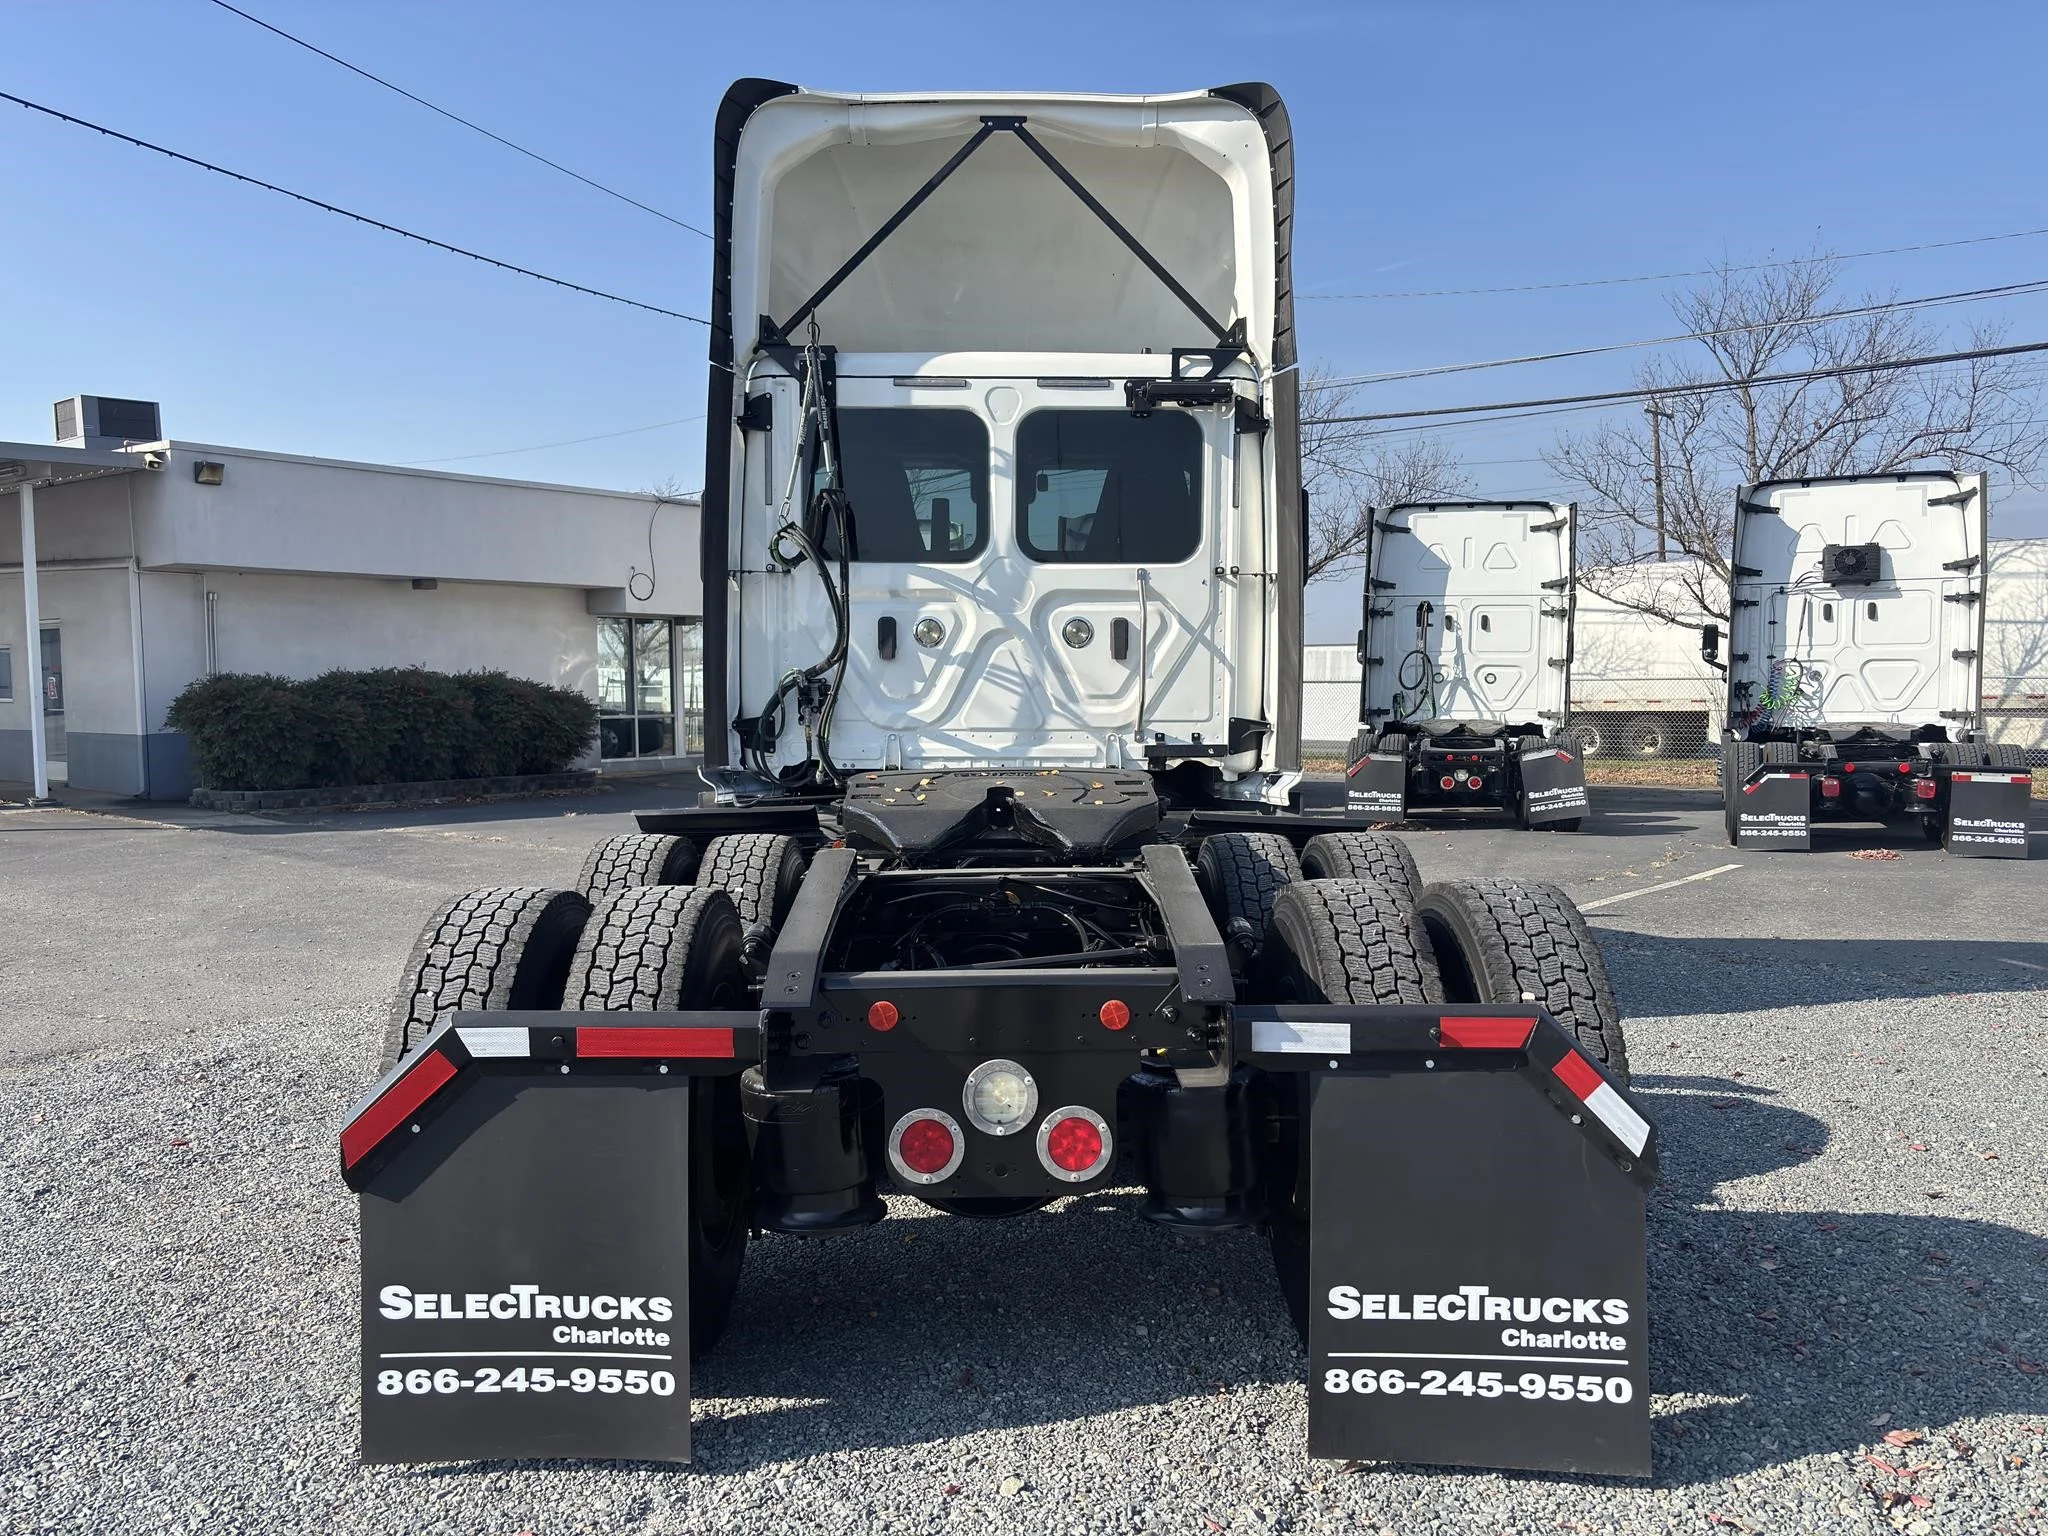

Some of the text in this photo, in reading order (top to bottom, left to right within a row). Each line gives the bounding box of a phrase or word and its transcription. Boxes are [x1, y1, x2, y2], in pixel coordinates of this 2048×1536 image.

[1951, 834, 2025, 845] 866-245-9550
[552, 1325, 671, 1347] Charlotte
[1501, 1328, 1627, 1351] Charlotte
[376, 1367, 676, 1396] 866-245-9550
[1323, 1368, 1633, 1404] 866-245-9550
